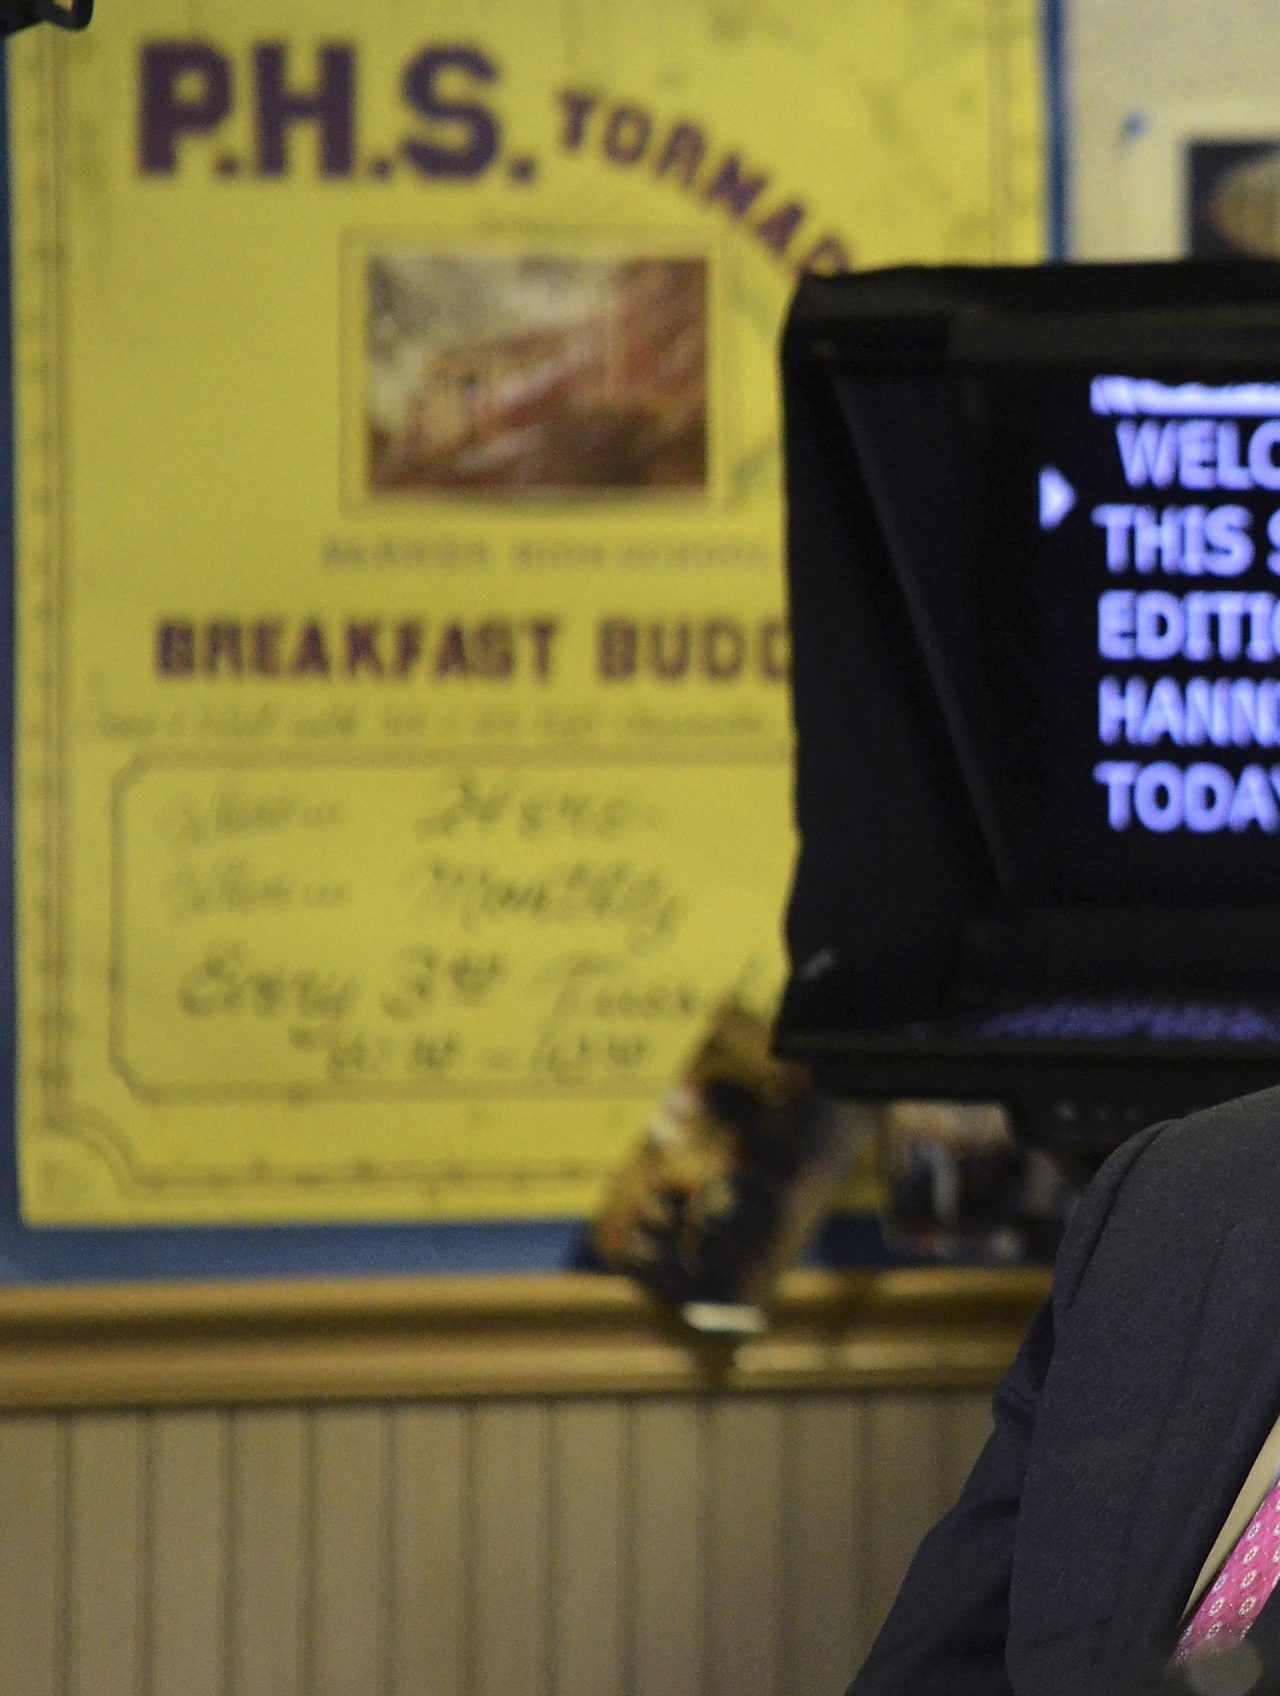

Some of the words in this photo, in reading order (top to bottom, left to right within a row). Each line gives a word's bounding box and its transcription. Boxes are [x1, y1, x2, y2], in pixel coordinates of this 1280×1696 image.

[137, 40, 536, 181] P.H.S.
[553, 88, 850, 278] TORNAD
[1092, 503, 1256, 577] THIS
[155, 616, 559, 682] BREAKFAST
[595, 615, 791, 684] BUDD
